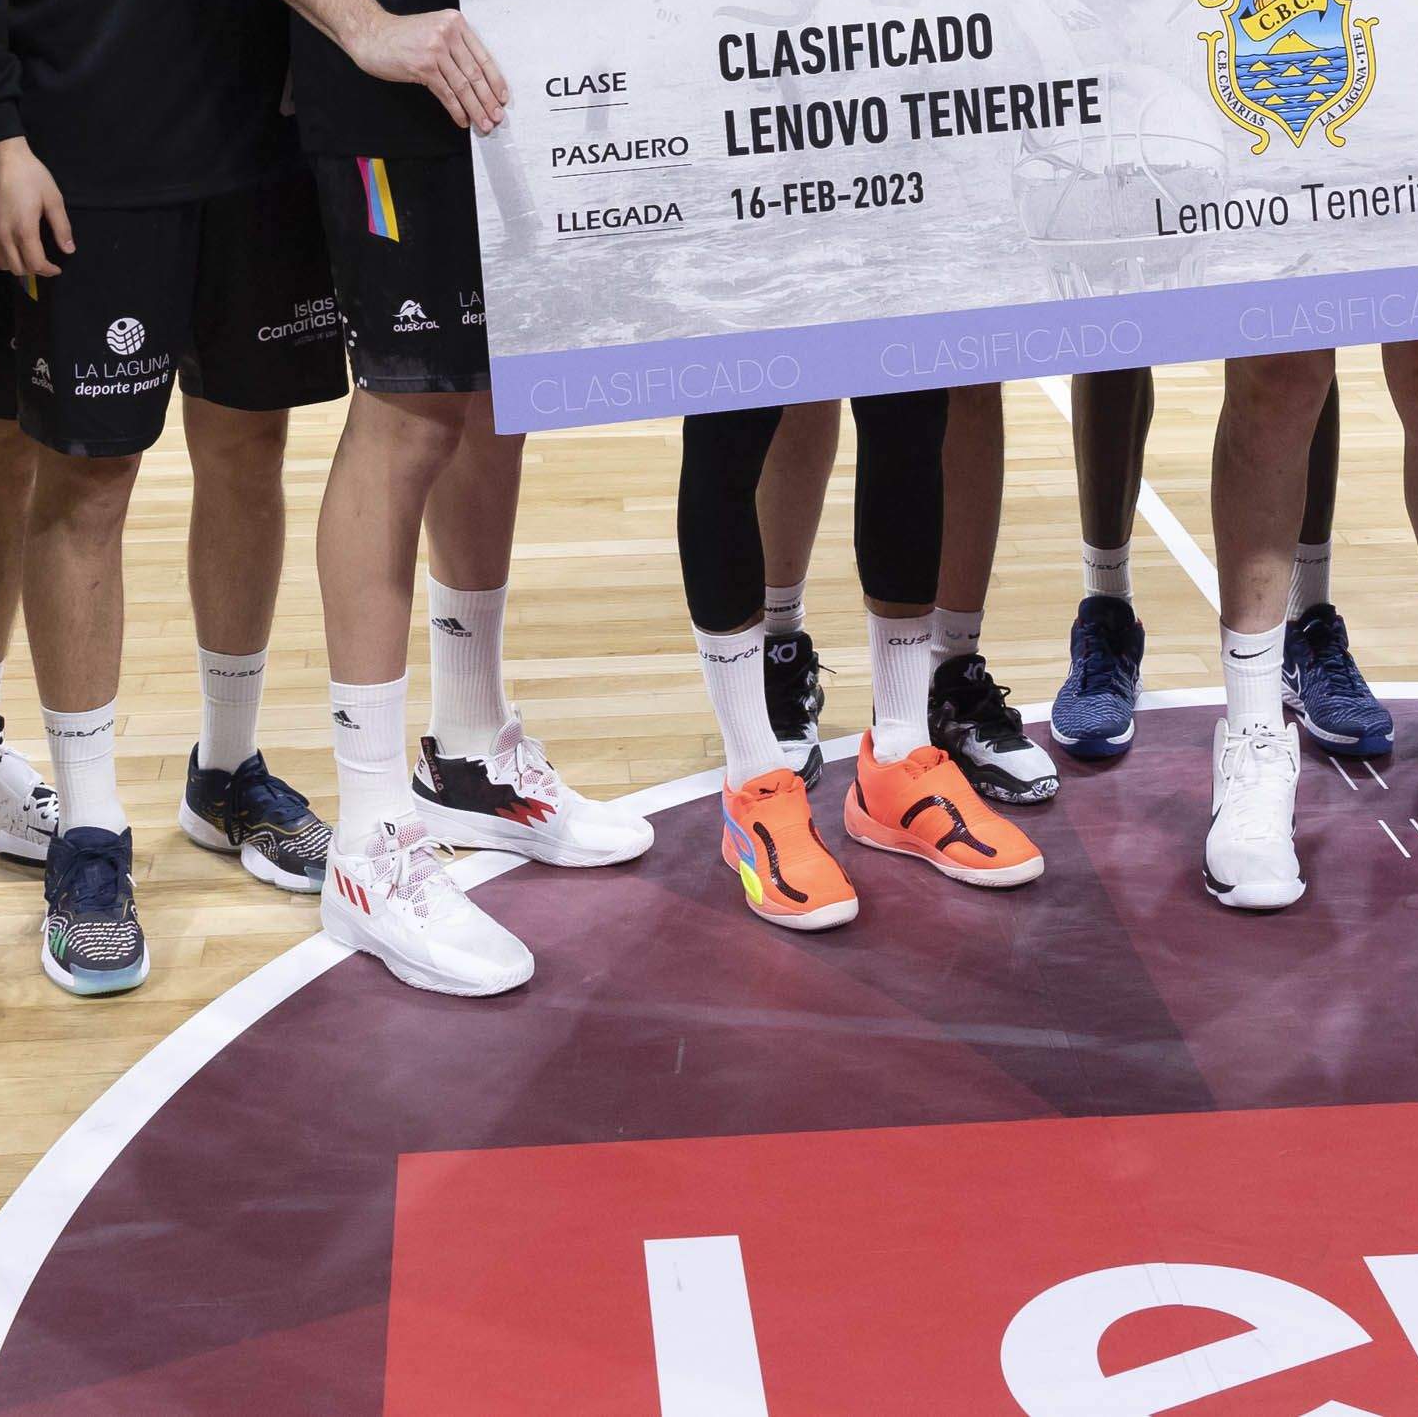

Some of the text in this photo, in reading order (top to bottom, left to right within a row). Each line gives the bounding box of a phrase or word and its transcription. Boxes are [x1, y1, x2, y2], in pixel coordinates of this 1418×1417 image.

[718, 12, 993, 82] CLASIFICADO
[545, 72, 627, 98] CLASE
[1219, 74, 1266, 128] CANARIAS
[1318, 111, 1336, 128] LA
[1338, 66, 1368, 112] LAGUNA
[724, 78, 1102, 157] LENOVO TENERIFE
[551, 136, 690, 168] PASAJERO
[731, 171, 924, 220] 16-FEB-2023
[1155, 191, 1289, 236] Lenovo
[556, 202, 683, 234] LLEGADA
[294, 296, 335, 319] Islas
[393, 320, 440, 333] austral
[257, 311, 336, 343] Canarias
[75, 352, 171, 380] LA LAGUNA
[880, 320, 1144, 379] CLASIFICADO
[75, 380, 130, 398] deporte
[134, 376, 160, 394] para
[531, 355, 801, 415] CLASIFICADO
